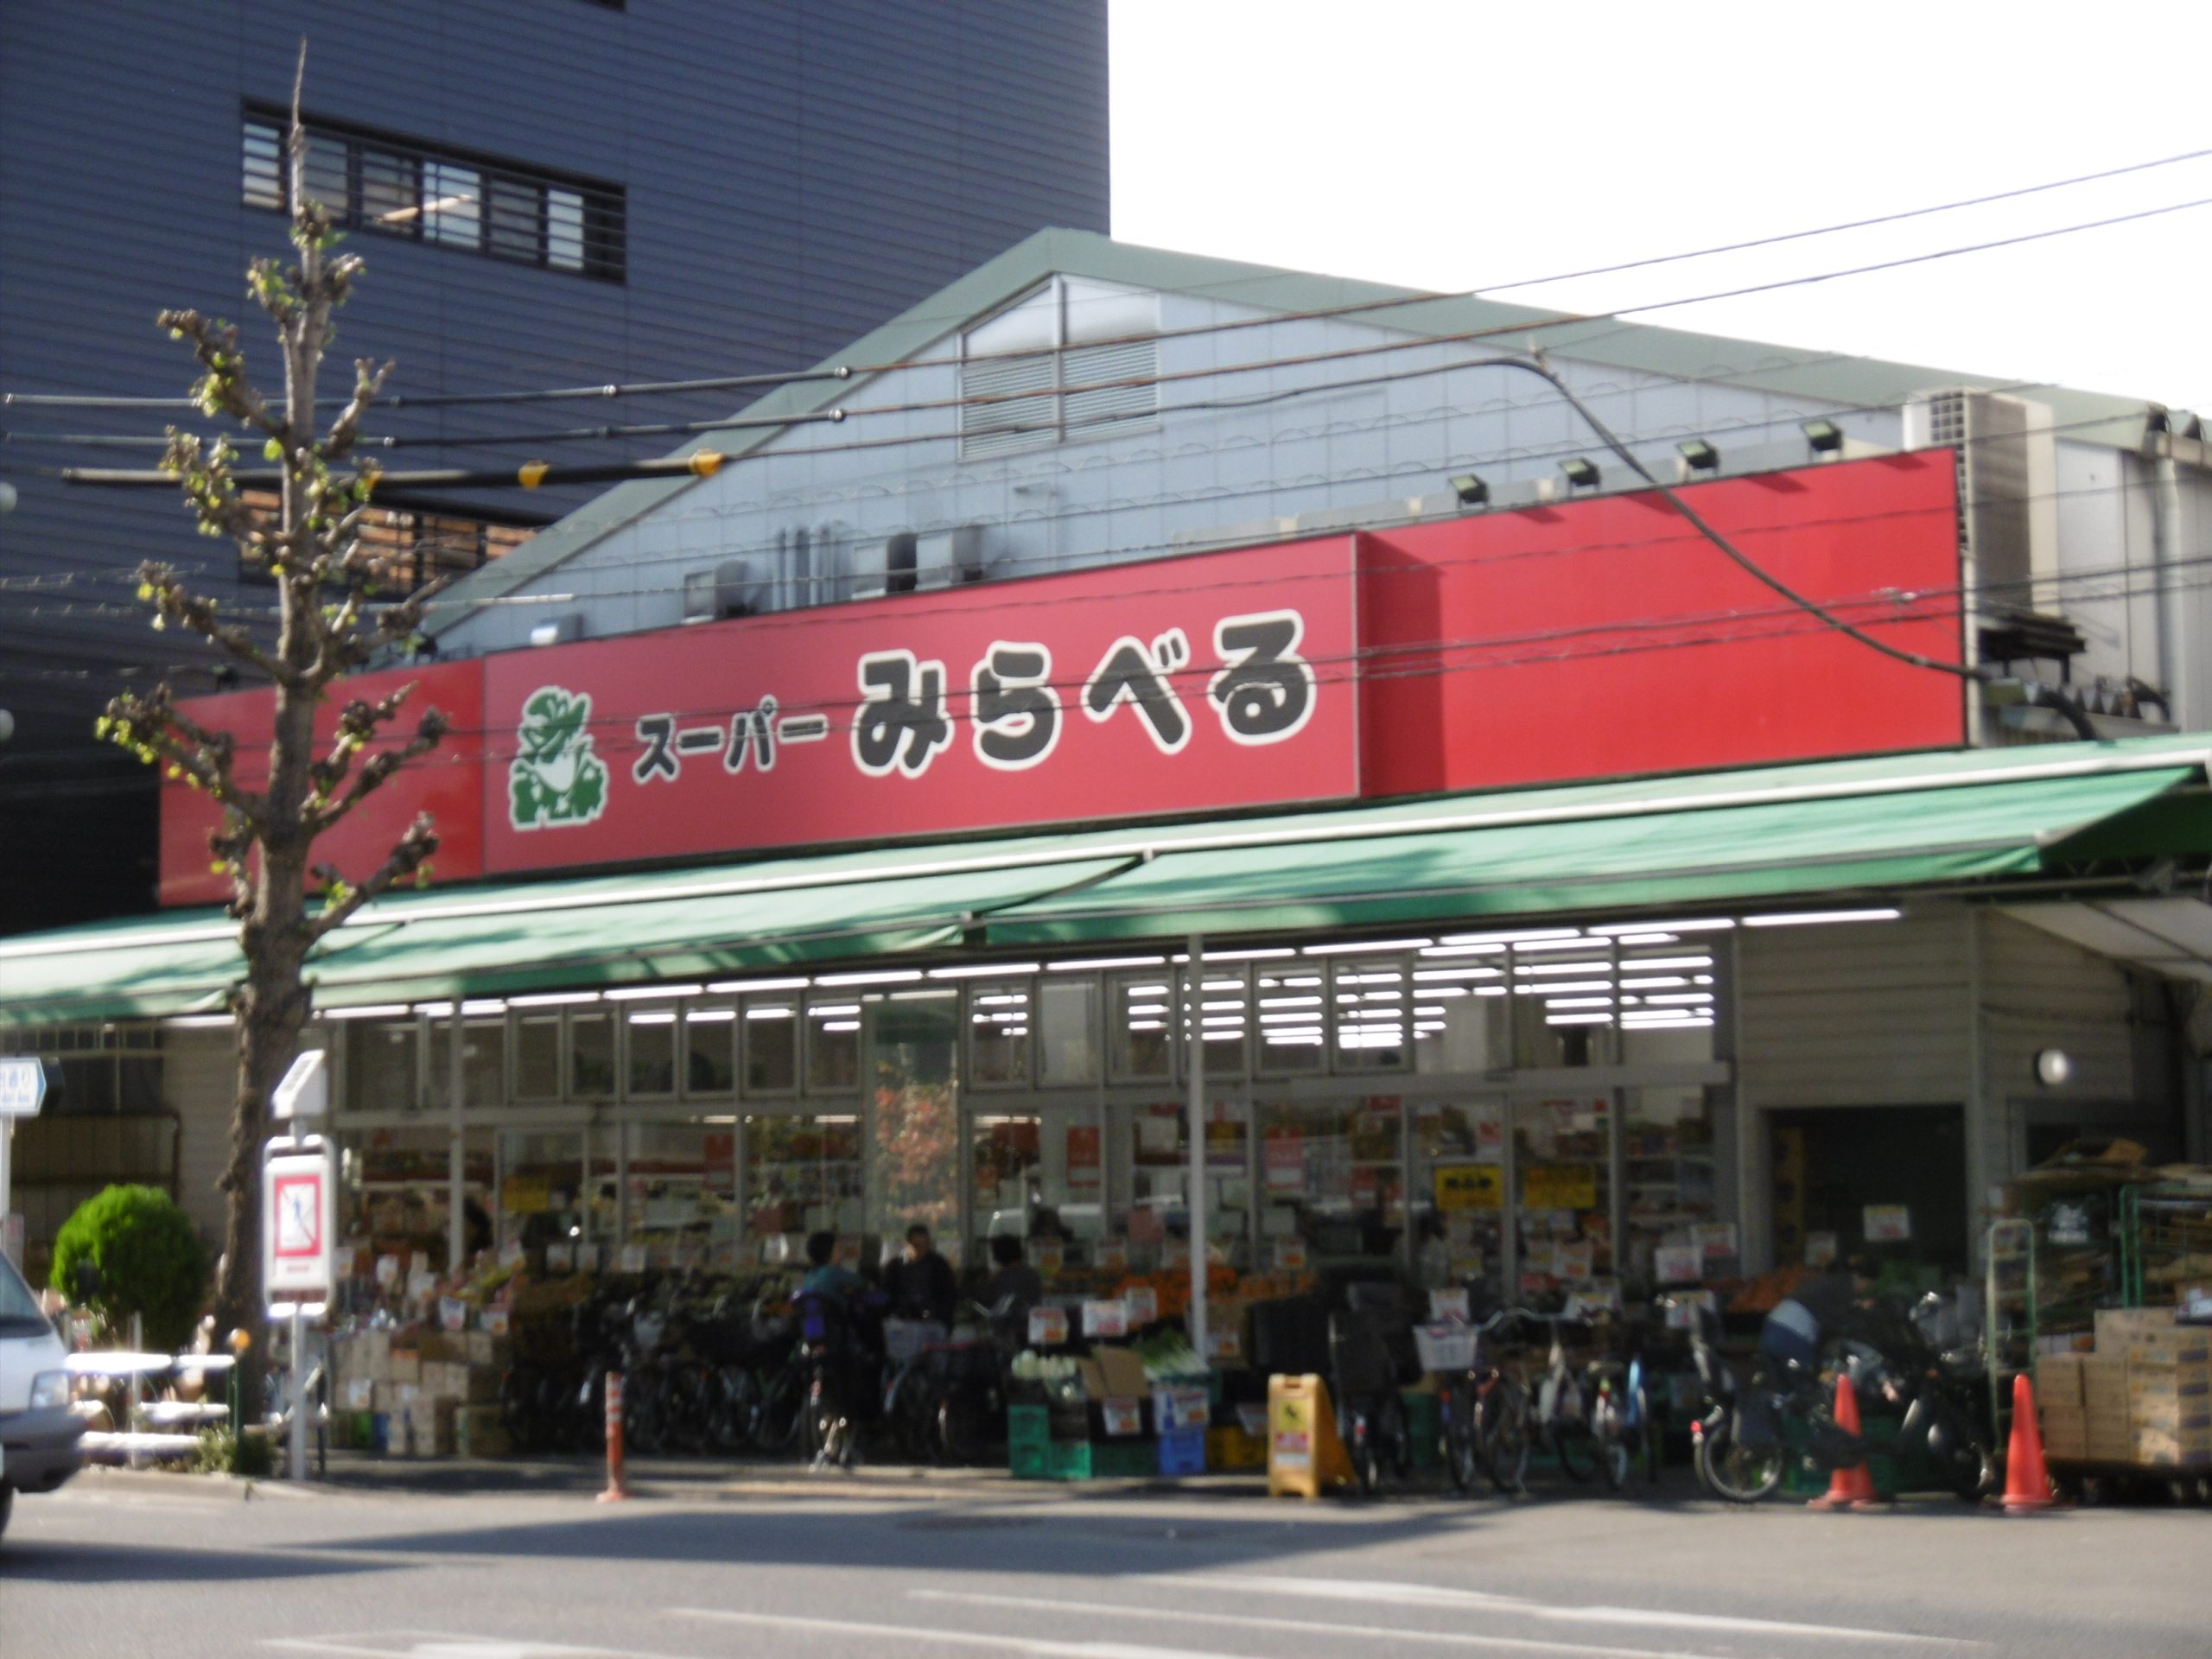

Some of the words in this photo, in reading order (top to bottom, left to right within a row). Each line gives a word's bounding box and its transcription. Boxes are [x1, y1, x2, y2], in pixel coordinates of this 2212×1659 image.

[633, 695, 828, 784] スーパー
[851, 609, 1316, 778] みらべる
